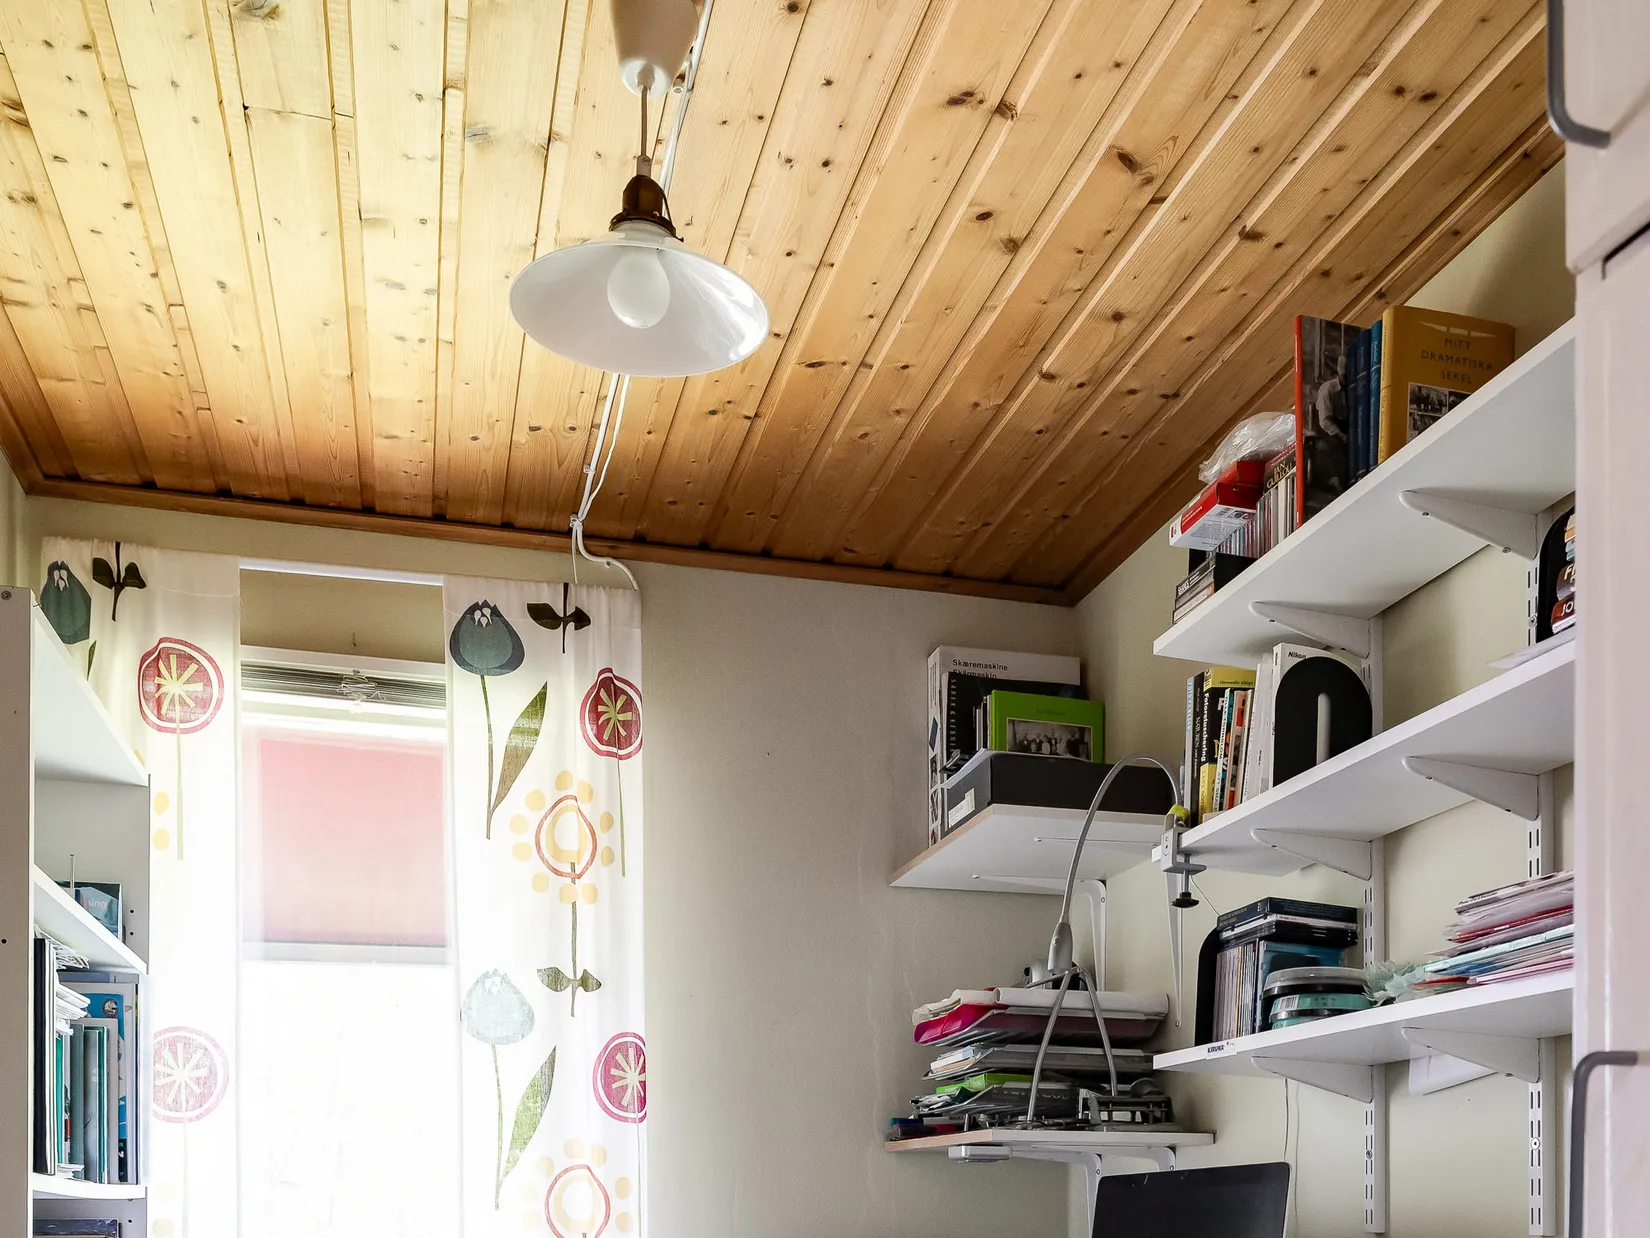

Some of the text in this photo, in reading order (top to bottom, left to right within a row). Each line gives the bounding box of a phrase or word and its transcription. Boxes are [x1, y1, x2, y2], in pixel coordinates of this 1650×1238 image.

[1444, 337, 1473, 351] MITT
[1421, 350, 1494, 371] DRAMATISKA
[1440, 370, 1474, 385] SEKEL
[1288, 651, 1307, 660] Nikon
[952, 659, 1008, 671] Skæremaskine
[1200, 692, 1210, 762] Fotoretuschering
